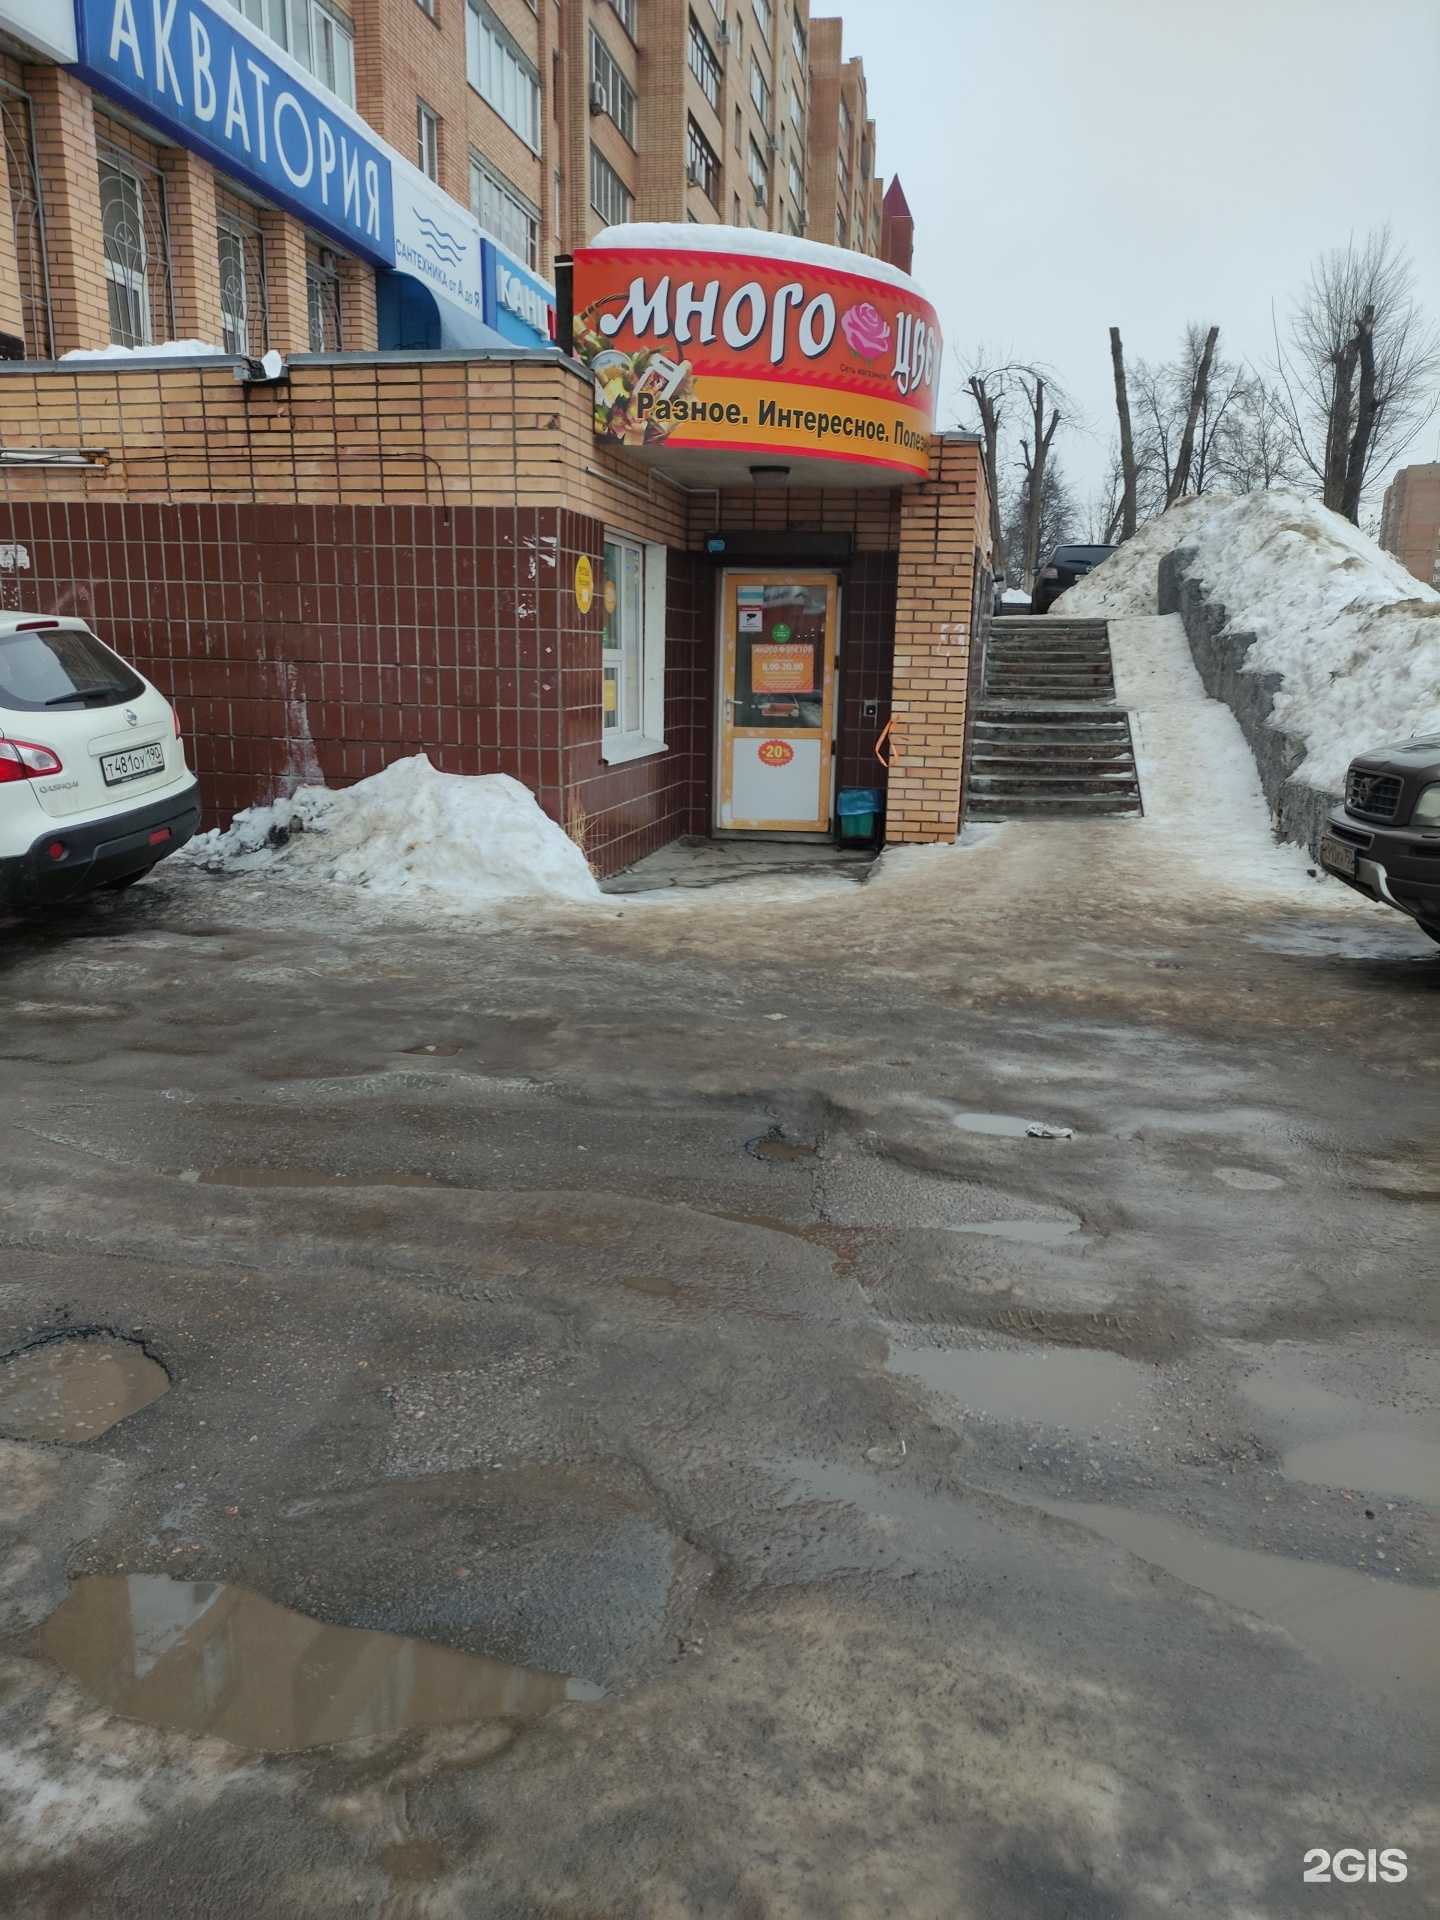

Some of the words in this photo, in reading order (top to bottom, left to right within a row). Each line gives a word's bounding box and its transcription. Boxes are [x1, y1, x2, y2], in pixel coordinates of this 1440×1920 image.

[109, 0, 381, 241] АКВАТОРИЯ
[396, 239, 448, 287] САНТЕХНИКА
[458, 280, 464, 297] А
[474, 291, 480, 310] Я
[637, 393, 748, 424] Разное.
[758, 400, 888, 442] Интересное.
